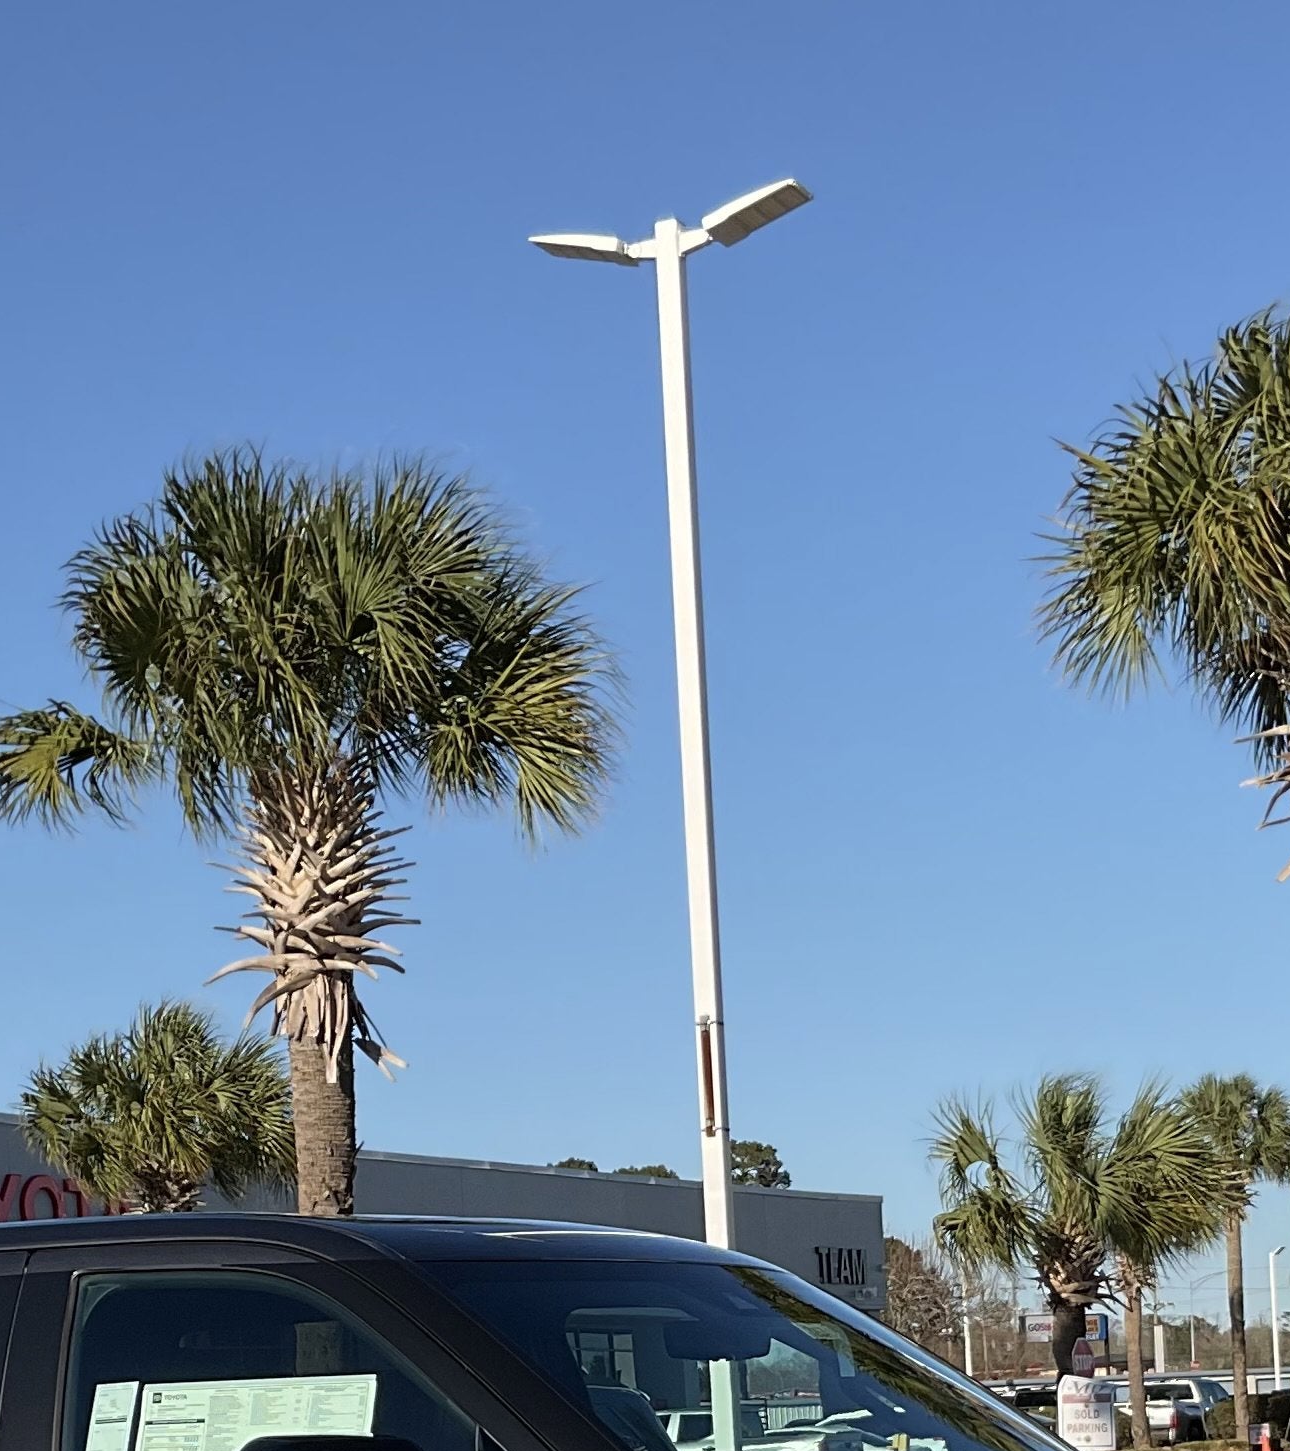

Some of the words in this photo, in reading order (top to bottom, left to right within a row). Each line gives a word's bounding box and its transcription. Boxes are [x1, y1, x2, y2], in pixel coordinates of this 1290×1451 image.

[814, 1246, 867, 1285] TEAM
[1074, 1409, 1100, 1419] SOLD
[1067, 1422, 1108, 1433] PARKING
